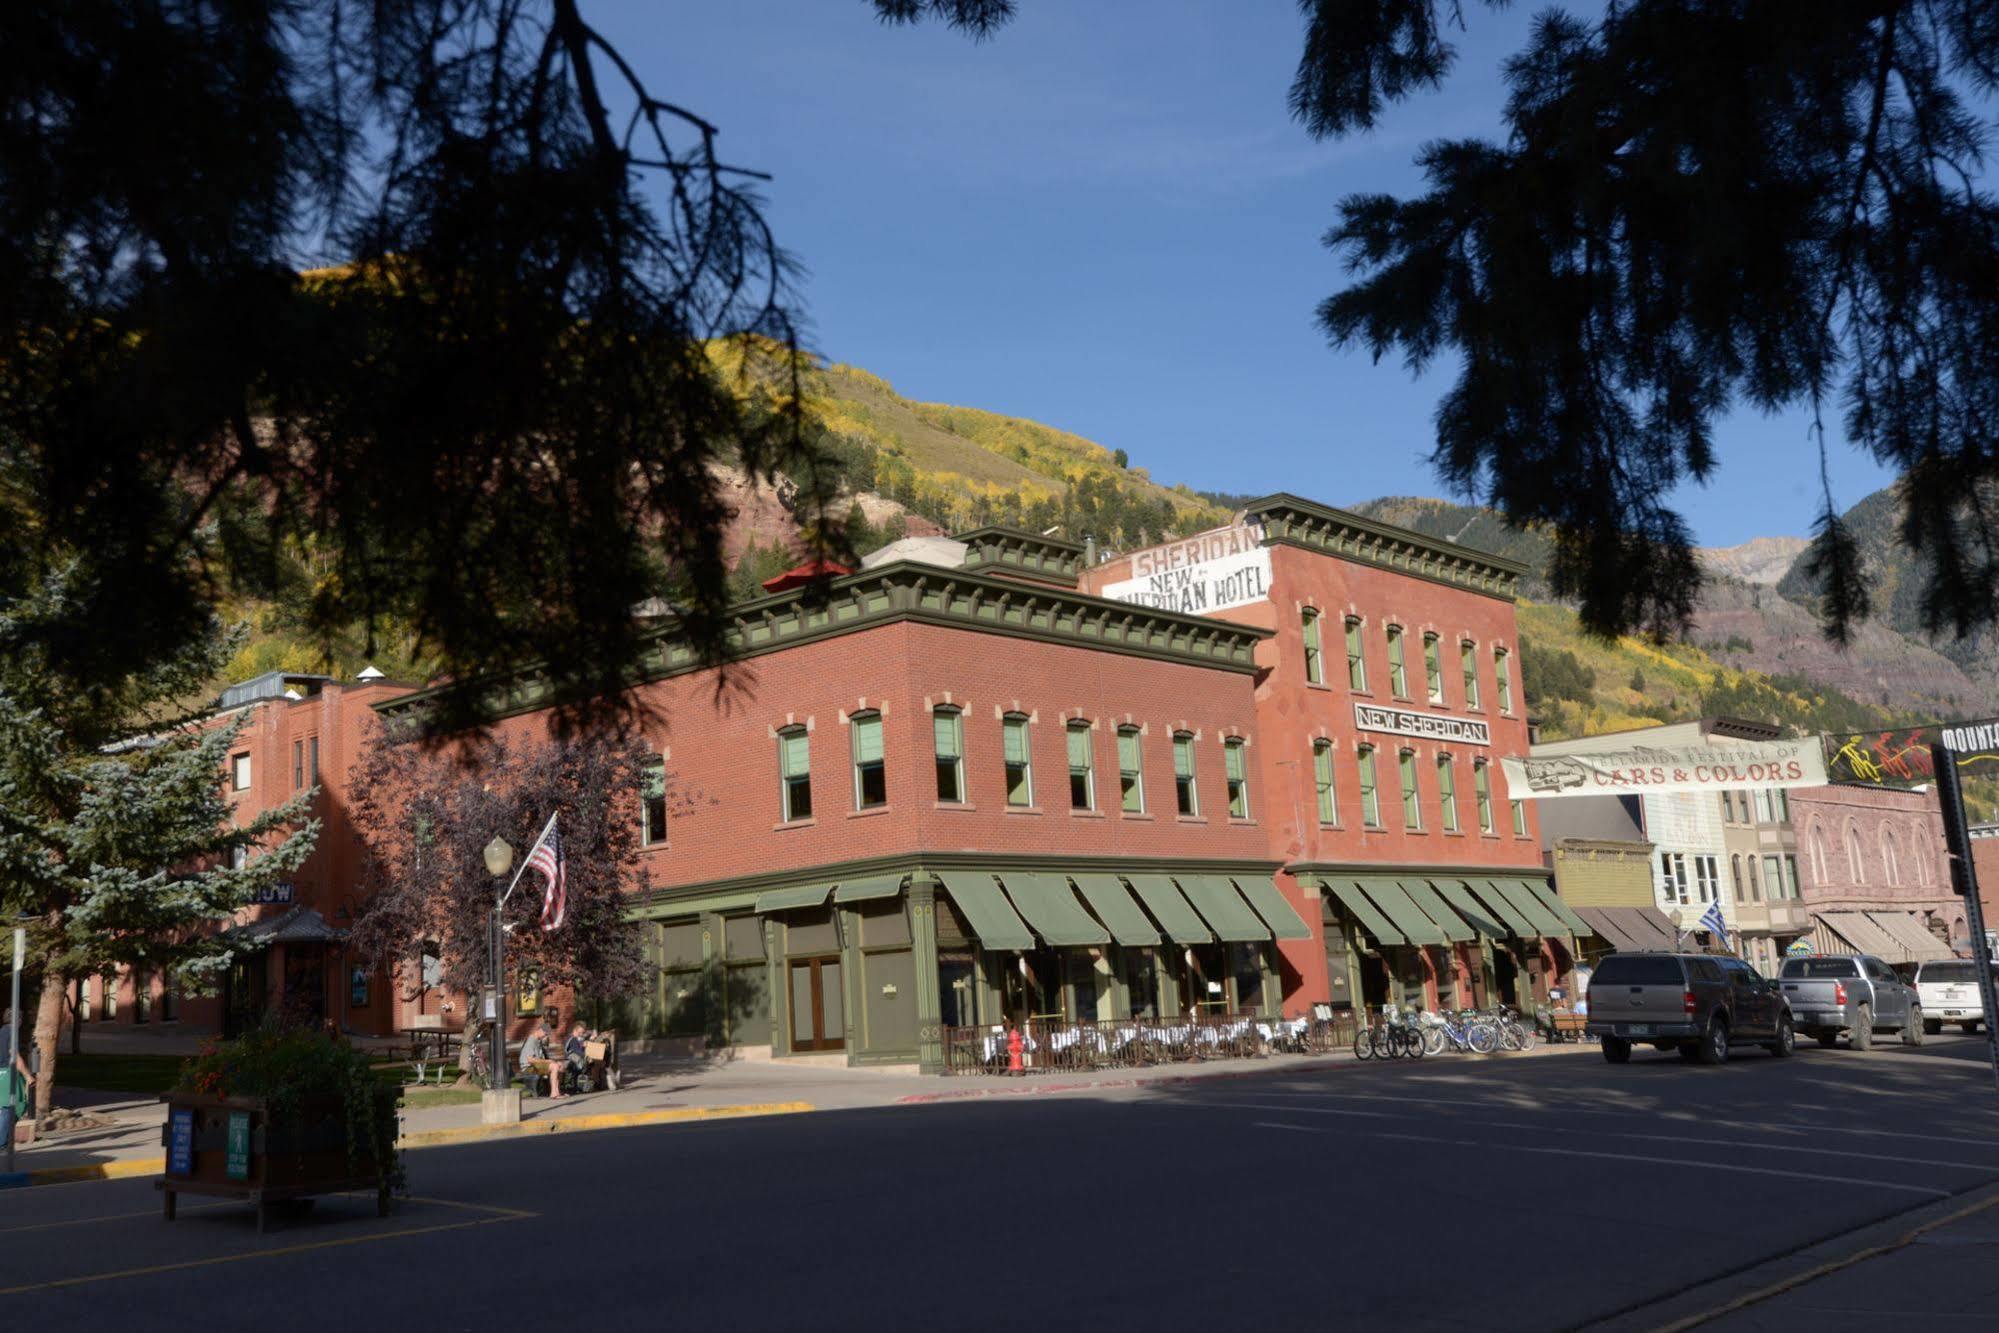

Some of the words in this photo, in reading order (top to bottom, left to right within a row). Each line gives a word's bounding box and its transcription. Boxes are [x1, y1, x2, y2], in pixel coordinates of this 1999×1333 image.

[1136, 527, 1261, 577] SHERIDAN
[1149, 566, 1193, 593] NEW
[1213, 566, 1267, 606] HOTEL
[1357, 707, 1395, 728] NEW
[1399, 715, 1484, 740] SHERIDAN
[1687, 750, 1769, 762] FESTIVAL
[1777, 746, 1799, 758] OF
[1592, 767, 1665, 786] CARS
[1672, 768, 1689, 782] &
[1694, 761, 1803, 783] COLORS
